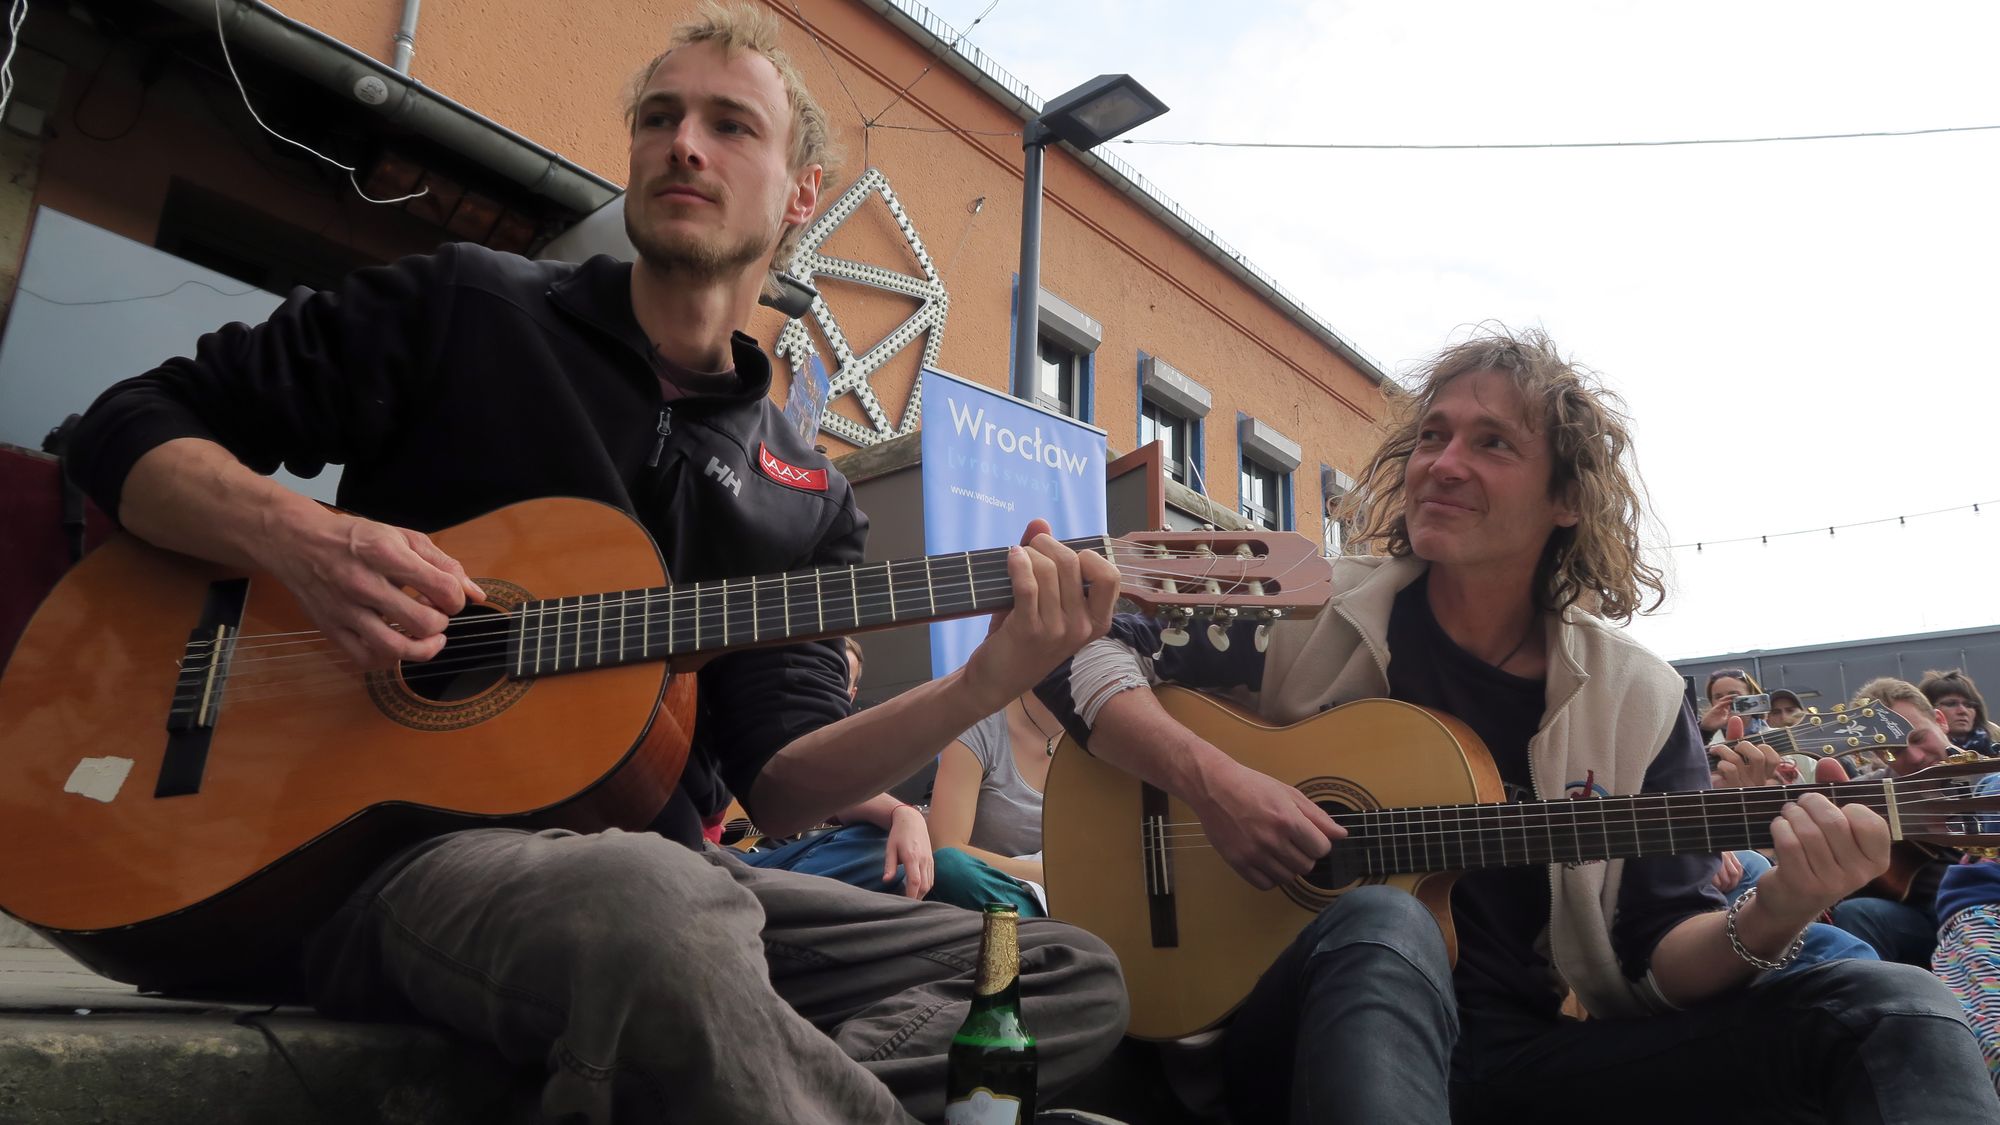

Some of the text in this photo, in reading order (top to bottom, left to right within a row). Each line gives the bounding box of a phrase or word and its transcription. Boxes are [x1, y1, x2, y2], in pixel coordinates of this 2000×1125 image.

[948, 398, 1088, 478] Wrocław
[704, 456, 742, 497] HH
[762, 448, 812, 483] LAAX
[950, 485, 1015, 512] www.wroclaw.pl
